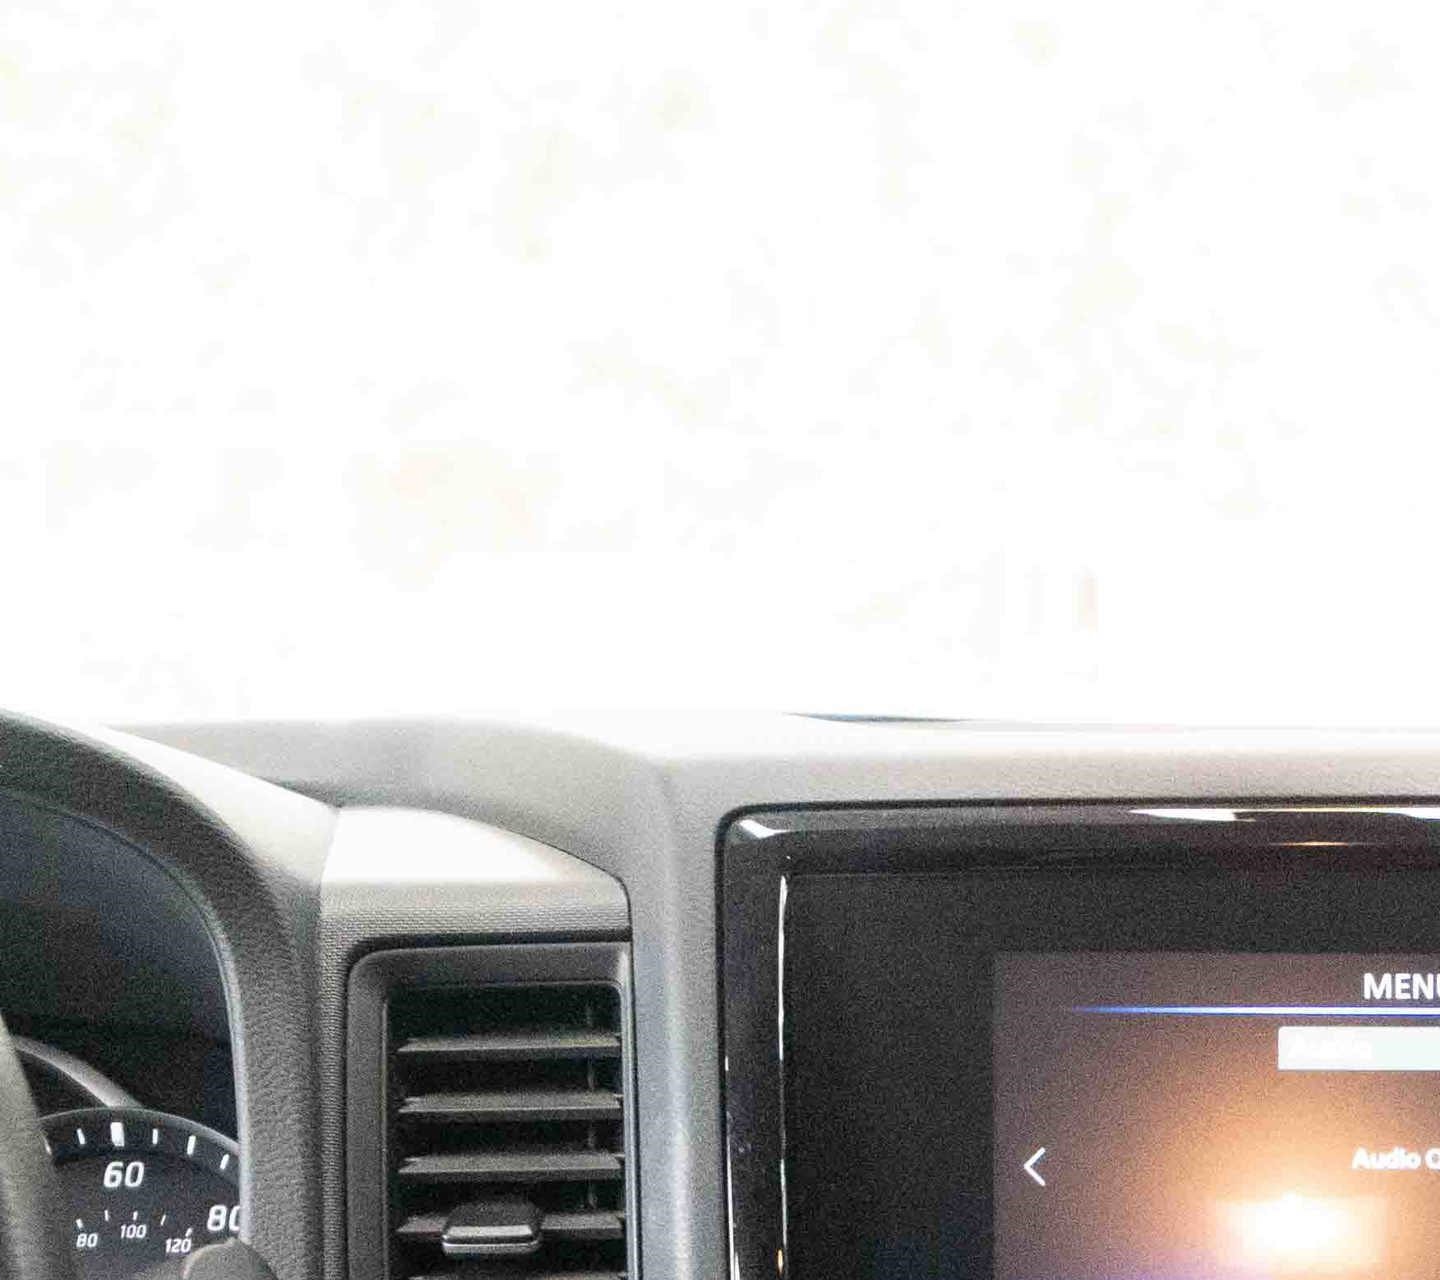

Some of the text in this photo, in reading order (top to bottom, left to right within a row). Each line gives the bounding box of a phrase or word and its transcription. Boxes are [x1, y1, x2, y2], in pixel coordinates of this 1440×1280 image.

[1351, 1146, 1421, 1170] Audio
[103, 1160, 145, 1189] 60
[120, 1223, 148, 1240] 100
[75, 1232, 99, 1249] 80
[165, 1238, 192, 1254] 120
